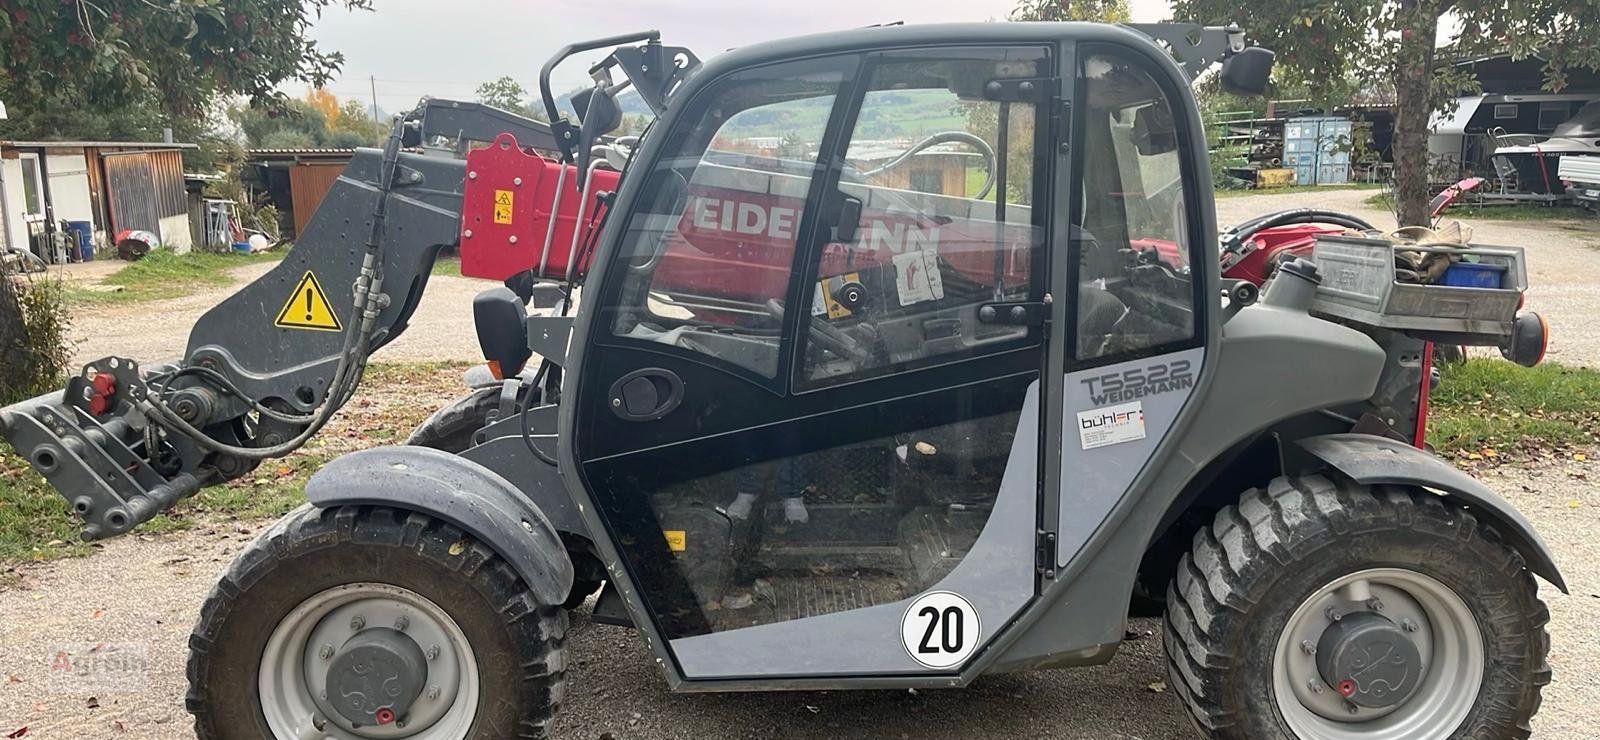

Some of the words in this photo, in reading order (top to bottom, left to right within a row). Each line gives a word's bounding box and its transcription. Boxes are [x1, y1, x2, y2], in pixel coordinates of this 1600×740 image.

[1080, 360, 1193, 396] T5522
[1090, 377, 1193, 406] WEIDEMANN
[918, 606, 964, 654] 20
